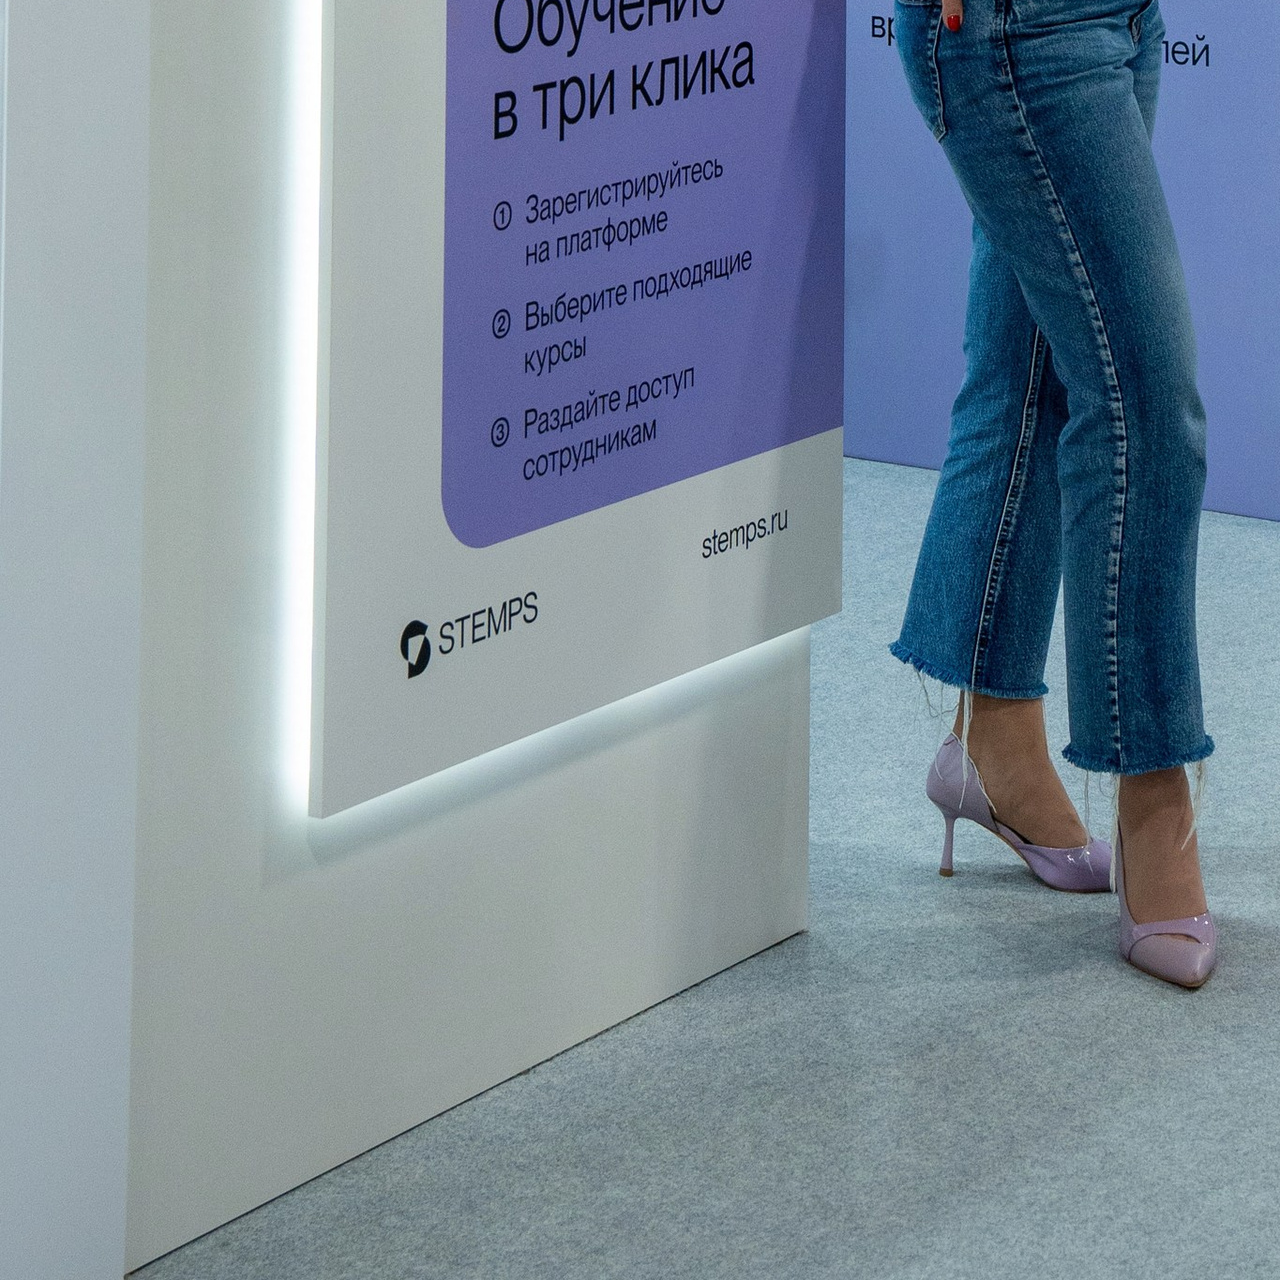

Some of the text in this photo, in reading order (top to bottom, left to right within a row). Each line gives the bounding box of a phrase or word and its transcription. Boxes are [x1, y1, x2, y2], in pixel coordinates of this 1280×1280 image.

[495, 42, 754, 141] в три клика
[525, 157, 724, 225] Зарегистрируйтесь
[526, 211, 668, 265] на платформе
[526, 284, 627, 331] Выберите
[633, 250, 752, 301] подходящие
[525, 337, 586, 376] курсы
[525, 390, 620, 438] Раздайте
[626, 367, 694, 411] доступ
[522, 419, 657, 481] сотрудникам
[702, 509, 788, 558] stemps.ru
[439, 592, 538, 654] STEMPS
